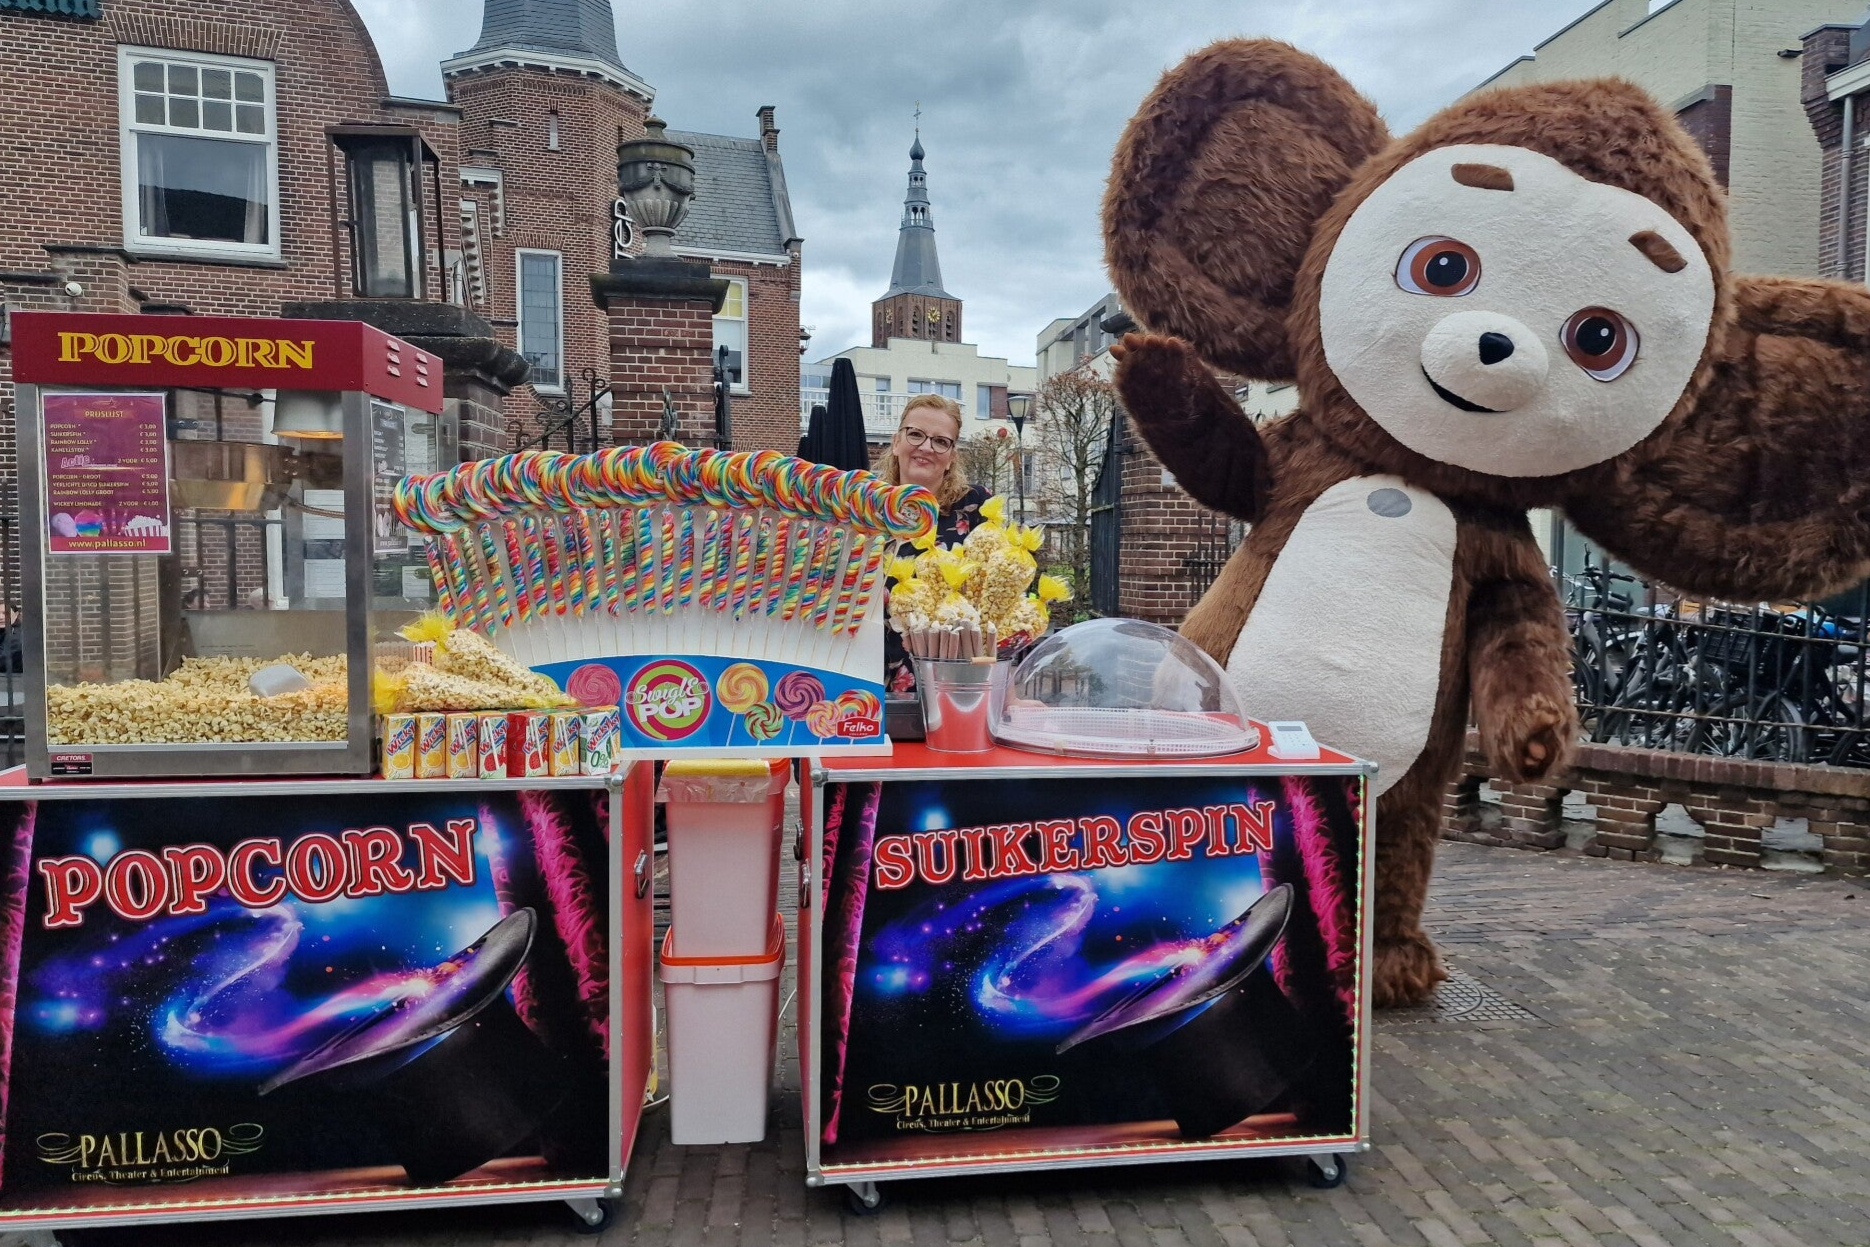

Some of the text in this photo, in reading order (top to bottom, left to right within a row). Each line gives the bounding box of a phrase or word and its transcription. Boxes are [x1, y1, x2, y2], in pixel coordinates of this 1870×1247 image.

[58, 332, 315, 369] POPCORN
[68, 538, 146, 549] www.pallasso.nl
[638, 696, 702, 723] POP
[450, 723, 478, 754] Wky
[522, 722, 549, 753] Wky
[553, 720, 580, 752] Wky
[843, 721, 874, 732] Felko
[874, 800, 1277, 892] SUIKERSPIN
[38, 818, 476, 929] POPCORN
[904, 1078, 1025, 1117] PALLASSO
[896, 1115, 1030, 1130] Circus, Theater & Entertainment
[80, 1127, 222, 1168] PALLASSO
[110, 1169, 147, 1180] Theater
[150, 1168, 156, 1178] &
[160, 1165, 230, 1178] Entertainment
